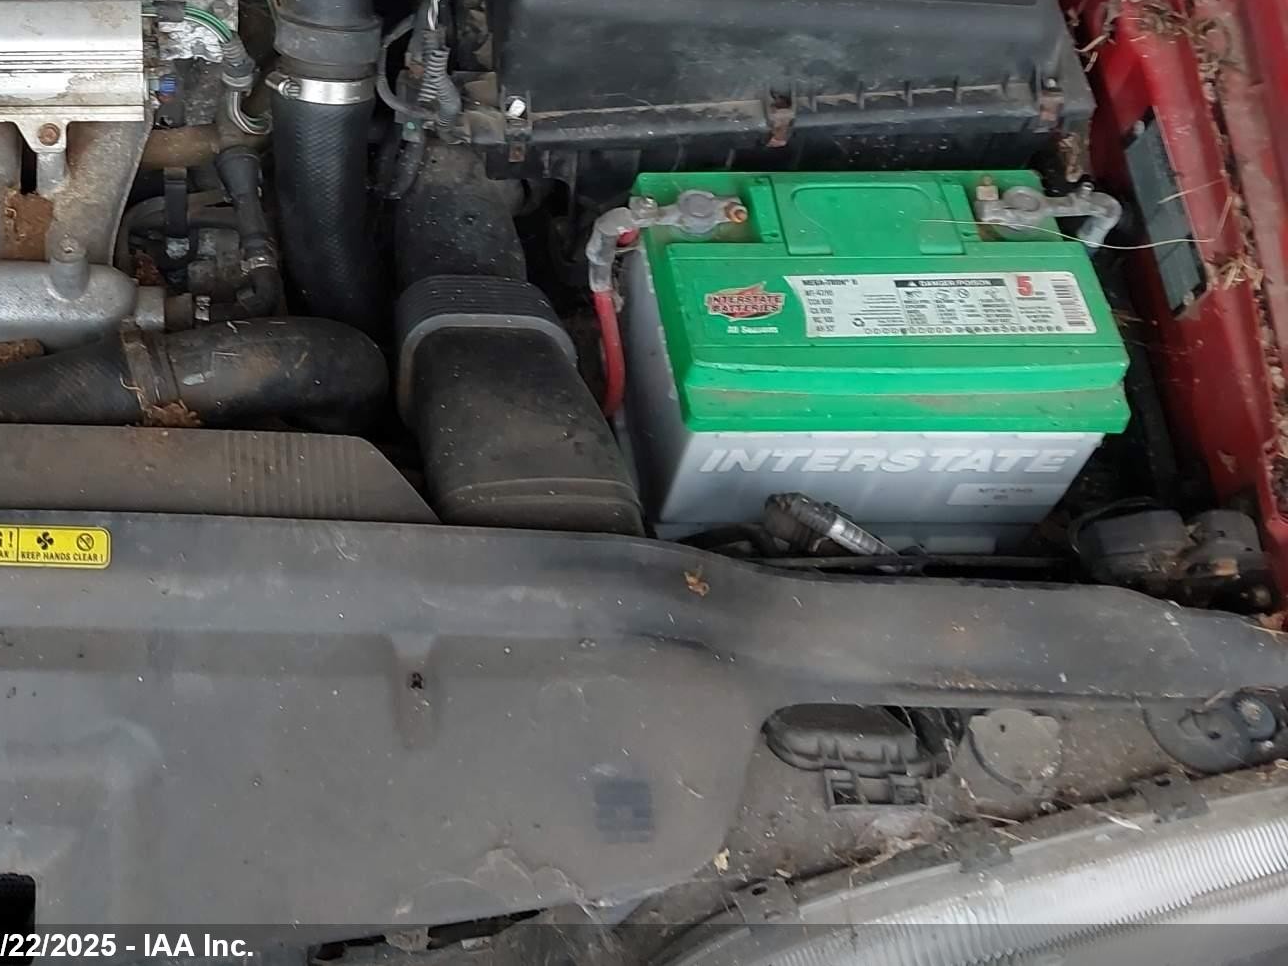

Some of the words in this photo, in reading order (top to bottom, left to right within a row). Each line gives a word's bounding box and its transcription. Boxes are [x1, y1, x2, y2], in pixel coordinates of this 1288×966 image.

[1016, 275, 1033, 296] 5
[706, 295, 782, 305] INTERSTATE
[710, 304, 780, 313] BATTERIES
[699, 449, 1075, 473] INTERSTATE
[21, 551, 40, 561] KEEP
[43, 552, 71, 561] HANDS
[73, 553, 98, 562] CLEAR
